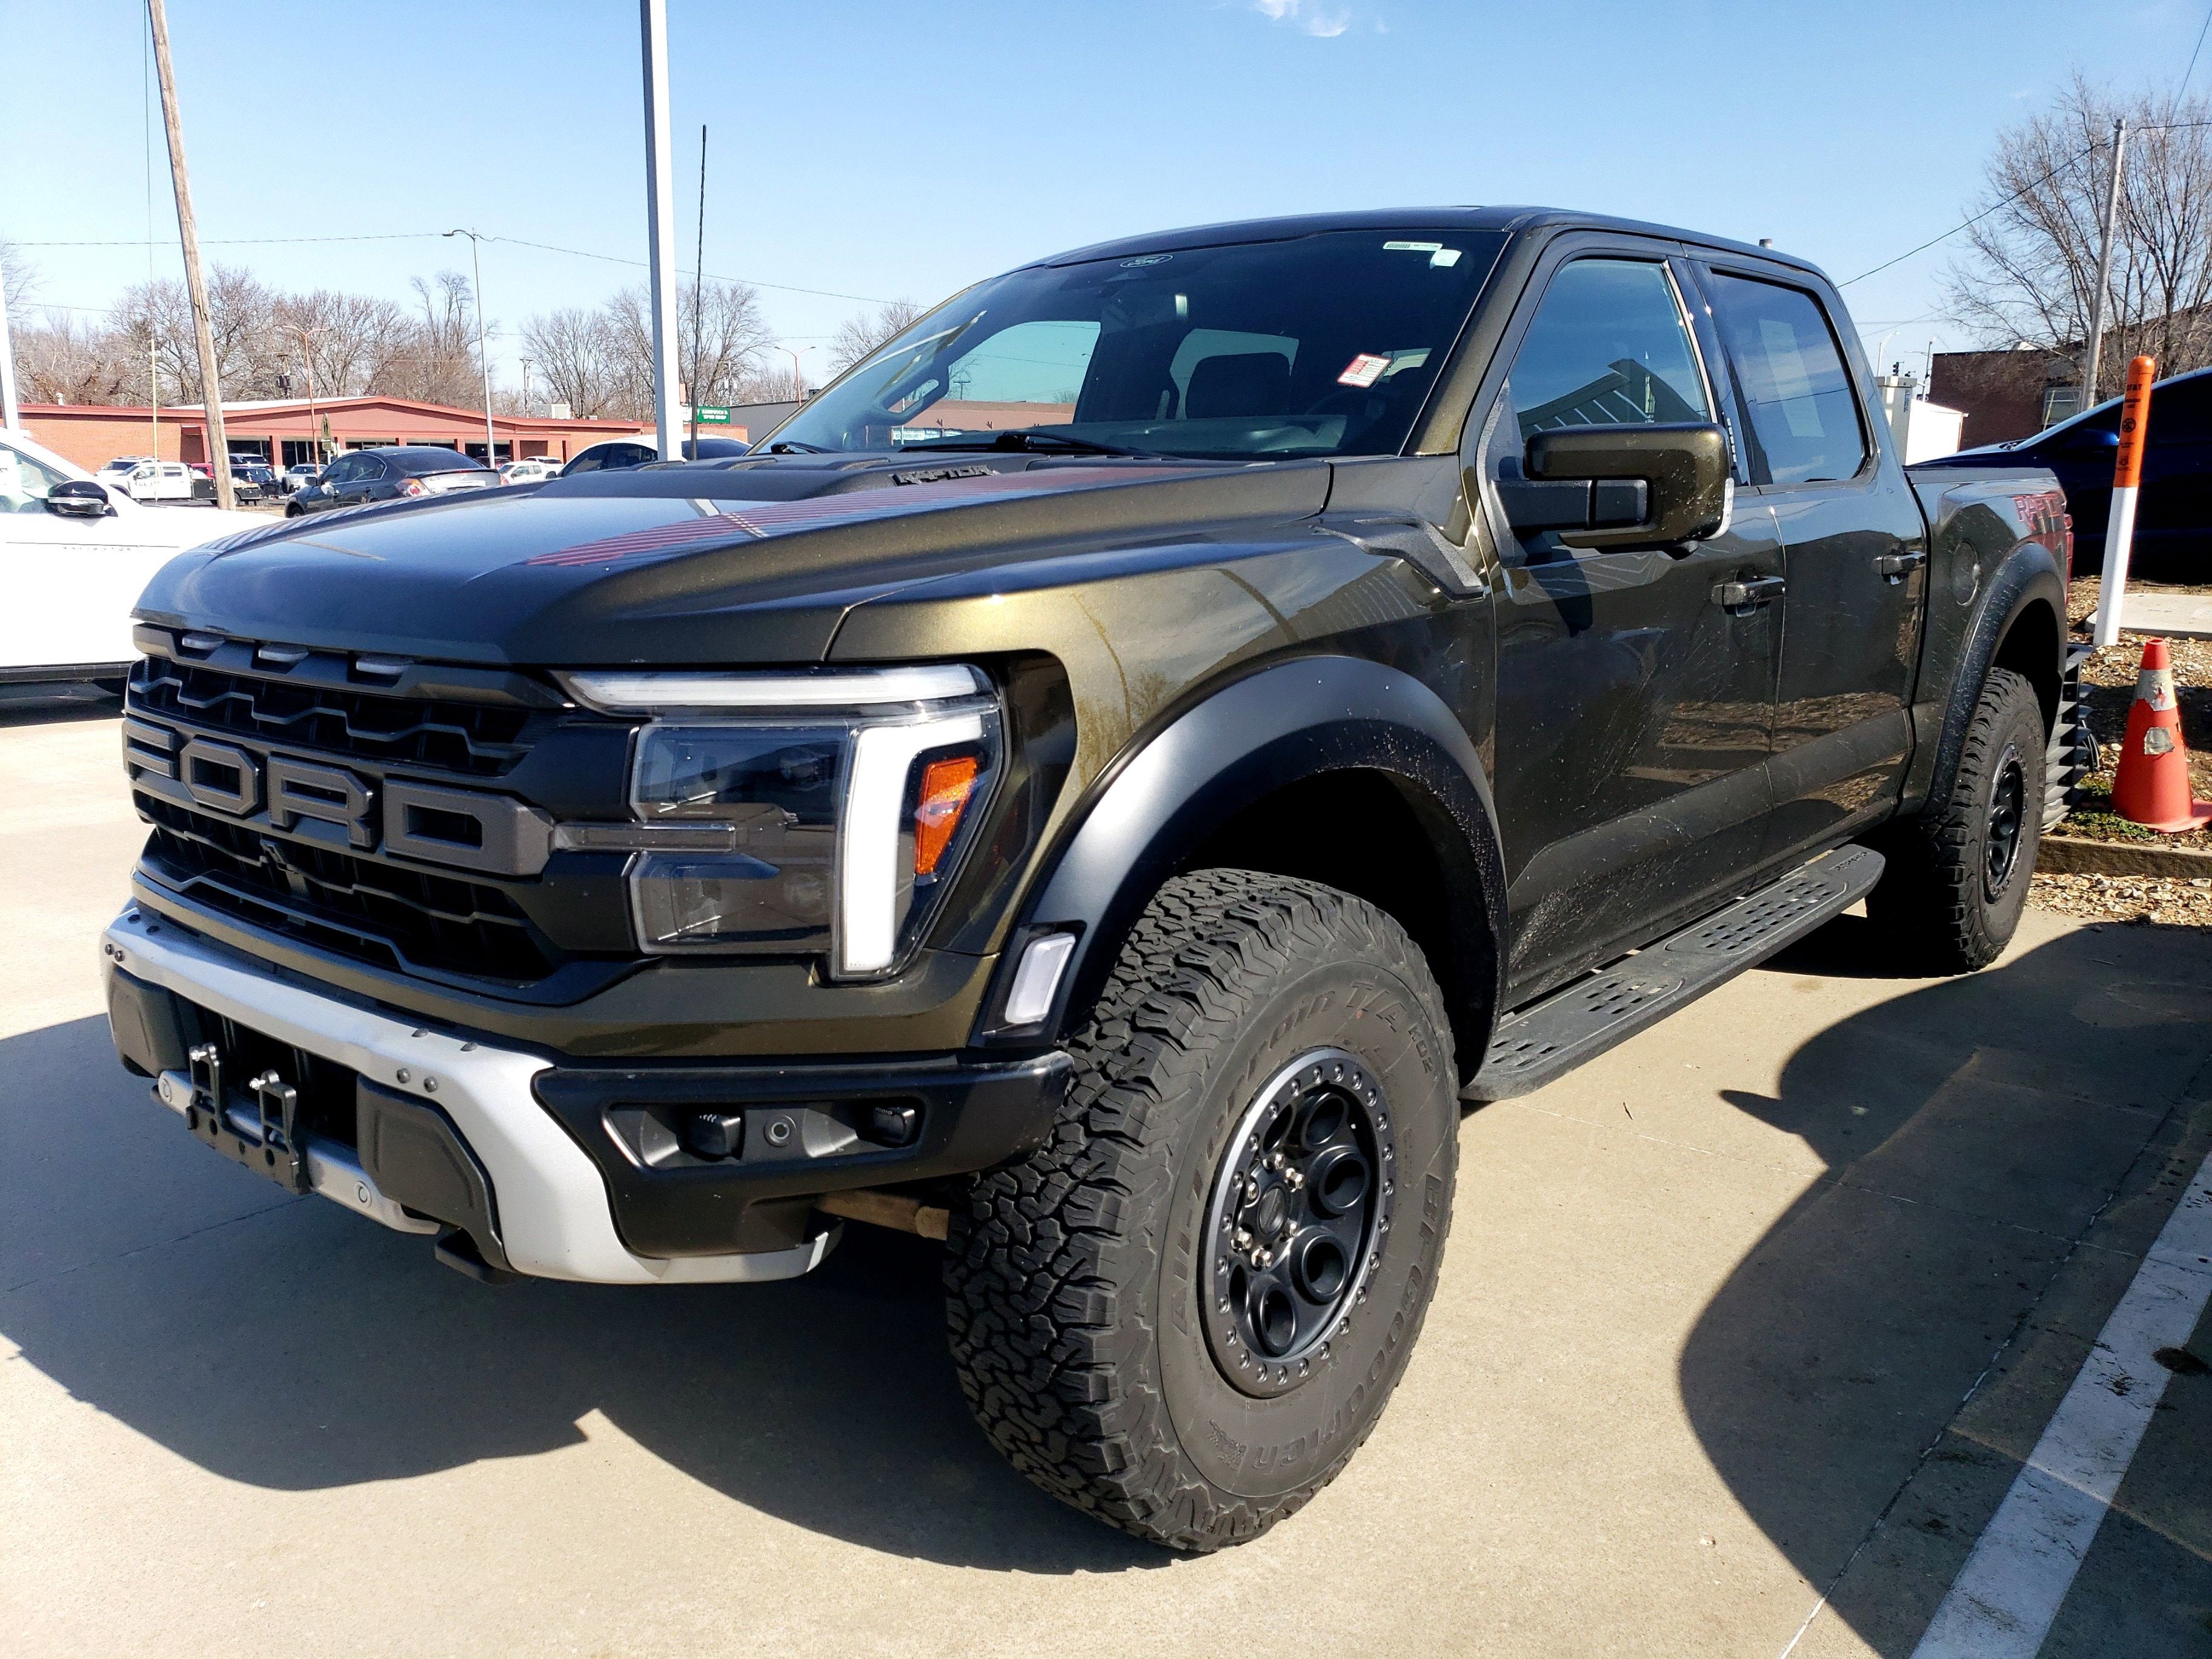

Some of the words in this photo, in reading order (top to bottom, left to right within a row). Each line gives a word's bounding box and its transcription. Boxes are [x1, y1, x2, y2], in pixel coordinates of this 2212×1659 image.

[888, 465, 1000, 486] RAPTOR
[121, 716, 554, 876] FORD
[1346, 982, 1407, 1032] T/A
[1252, 1173, 1443, 1470] BFGoodrich
